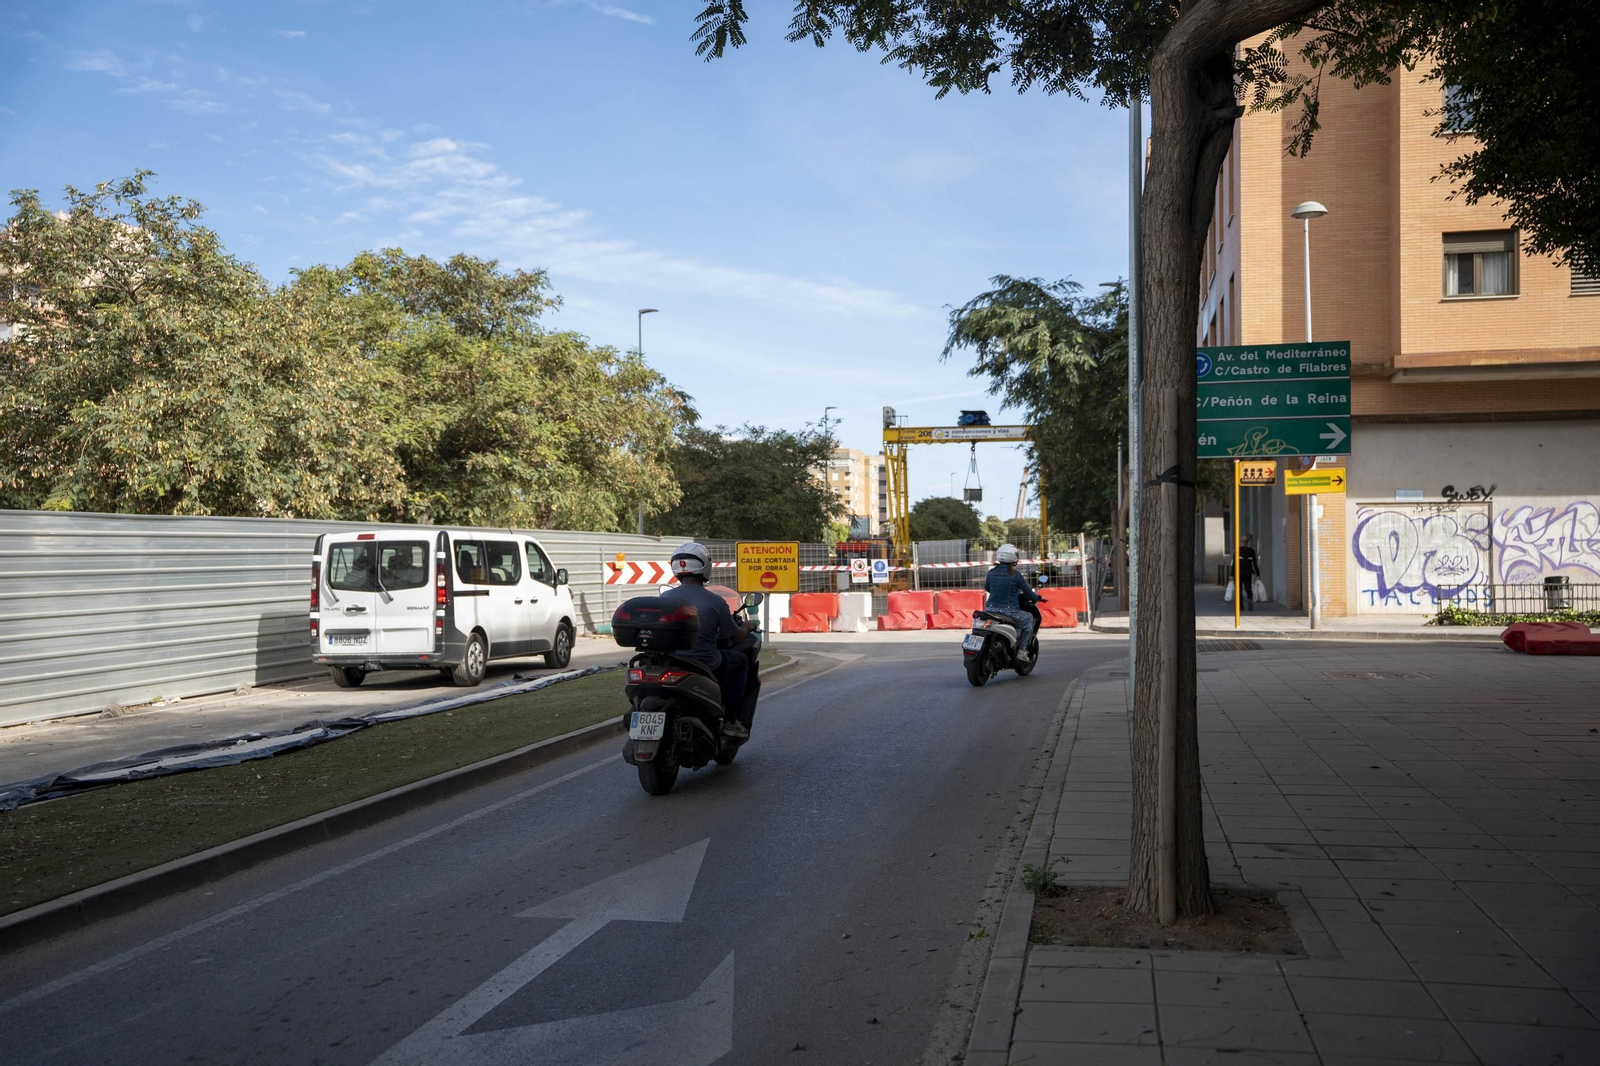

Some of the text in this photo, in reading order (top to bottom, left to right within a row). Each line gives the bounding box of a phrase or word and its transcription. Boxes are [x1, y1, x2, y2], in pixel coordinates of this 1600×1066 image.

[1218, 347, 1347, 361] Av. del Mediterráneo
[1214, 362, 1347, 376] C/Castro de Filabres
[1261, 394, 1278, 405] de
[1286, 394, 1299, 404] la
[1307, 393, 1347, 404] Reina
[743, 545, 792, 554] ATENCIÓN
[639, 714, 663, 725] 6045
[640, 725, 660, 735] KNF
